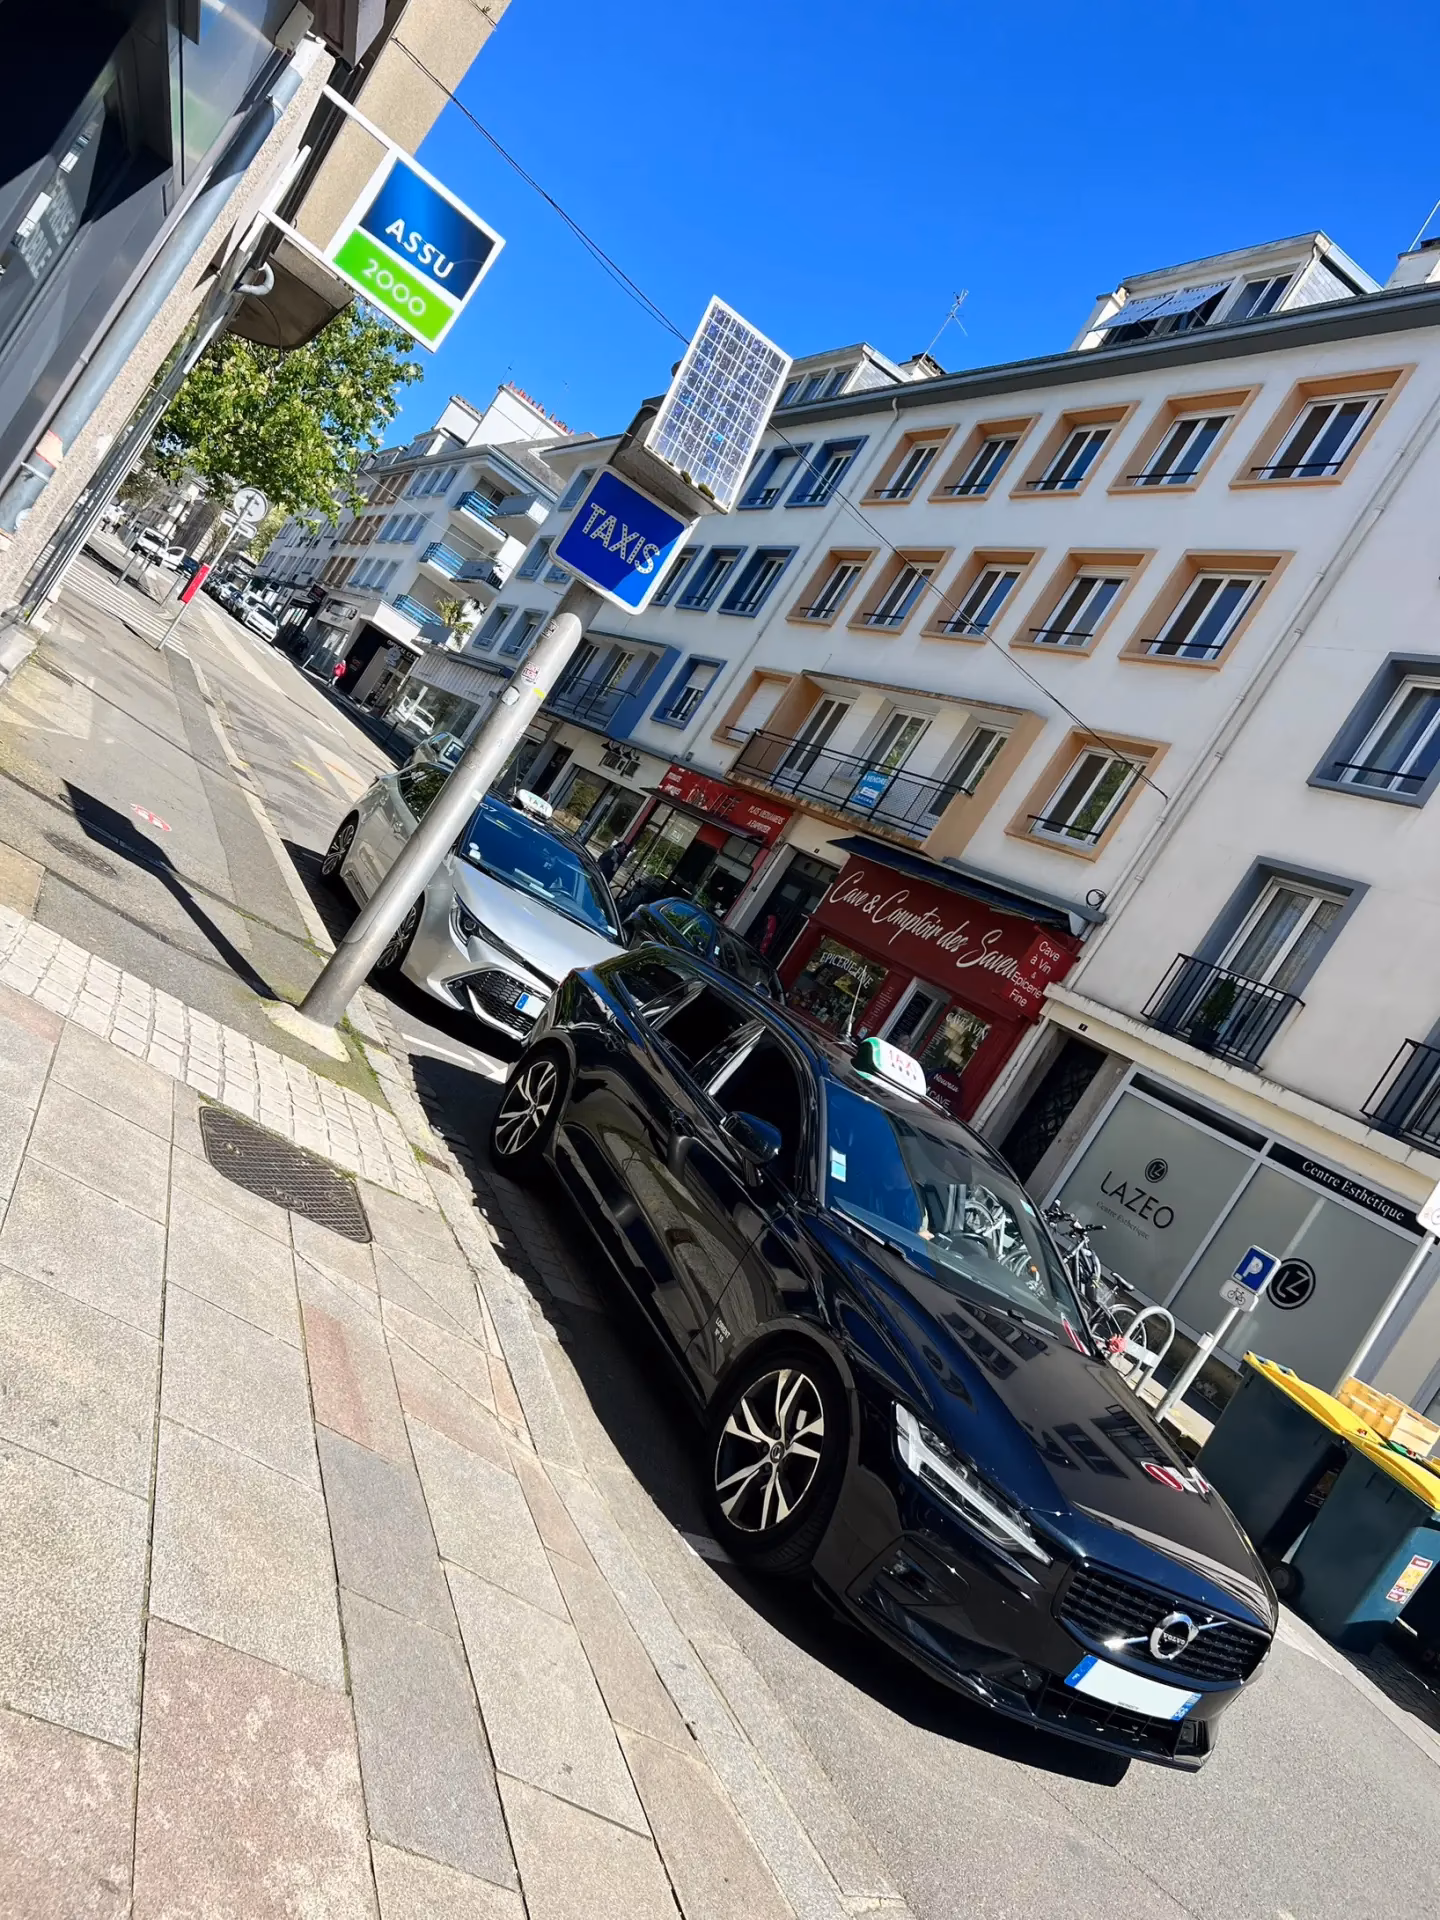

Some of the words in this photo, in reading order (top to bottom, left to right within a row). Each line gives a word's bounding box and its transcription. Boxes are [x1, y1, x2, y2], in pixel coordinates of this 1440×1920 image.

[385, 218, 454, 278] ASSU
[362, 258, 427, 317] 2000
[582, 502, 660, 574] TAXIS
[829, 870, 869, 907] Cave
[862, 894, 881, 914] &
[871, 889, 944, 945] Comptoir
[936, 920, 970, 953] des
[1039, 941, 1060, 961] Cave
[1030, 953, 1039, 965] à
[1039, 958, 1052, 974] Vin
[1009, 988, 1028, 1007] Fine
[1011, 971, 1043, 999] Epicerie
[1101, 1171, 1174, 1229] LAZEO
[1302, 1160, 1341, 1188] Centre
[1341, 1180, 1405, 1221] Esthétique
[1242, 1256, 1264, 1278] P
[1163, 1632, 1186, 1646] VOLVO
